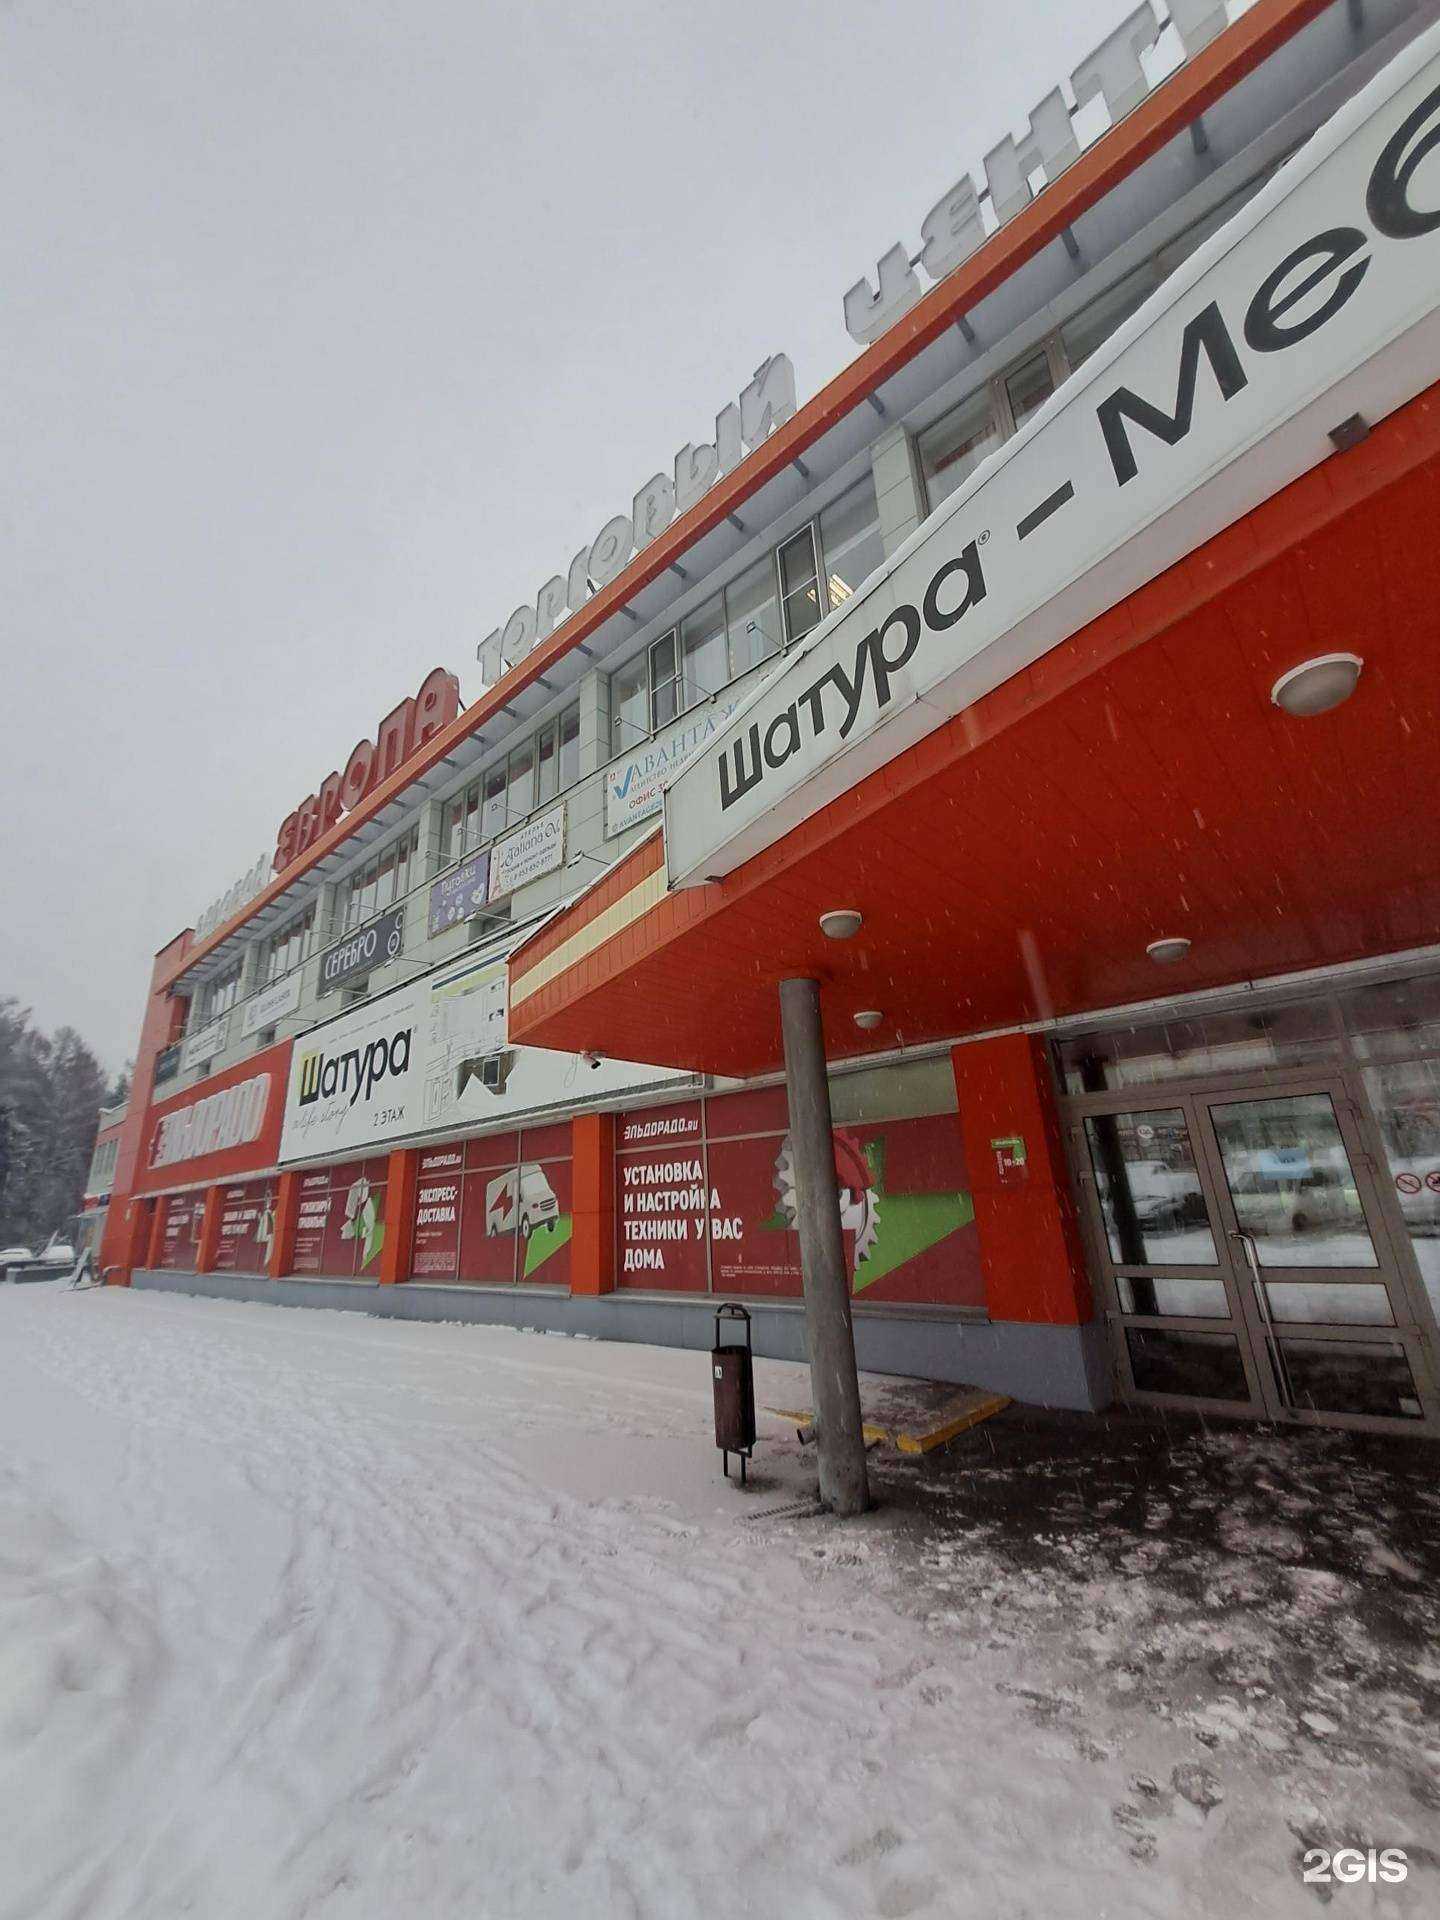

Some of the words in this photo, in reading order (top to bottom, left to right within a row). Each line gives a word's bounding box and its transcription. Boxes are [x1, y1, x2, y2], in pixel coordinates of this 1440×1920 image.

[477, 352, 797, 687] ТОРГОВЫЙ
[843, 0, 1232, 345] ЦЕНТ
[717, 540, 987, 811] Шатура
[628, 787, 655, 809] ОФИС
[325, 930, 377, 980] СЕРЕБРО
[299, 1029, 412, 1106] Шатура
[381, 1105, 406, 1125] ЭТАЖ
[624, 1160, 703, 1186] УСТАНОВКА
[416, 1207, 457, 1226] ДОСТАВКА
[624, 1194, 635, 1215] И
[624, 1219, 687, 1242] ТЕХНИКИ
[694, 1218, 705, 1241] У
[712, 1216, 743, 1240] ВАС
[624, 1248, 665, 1273] ДОМА
